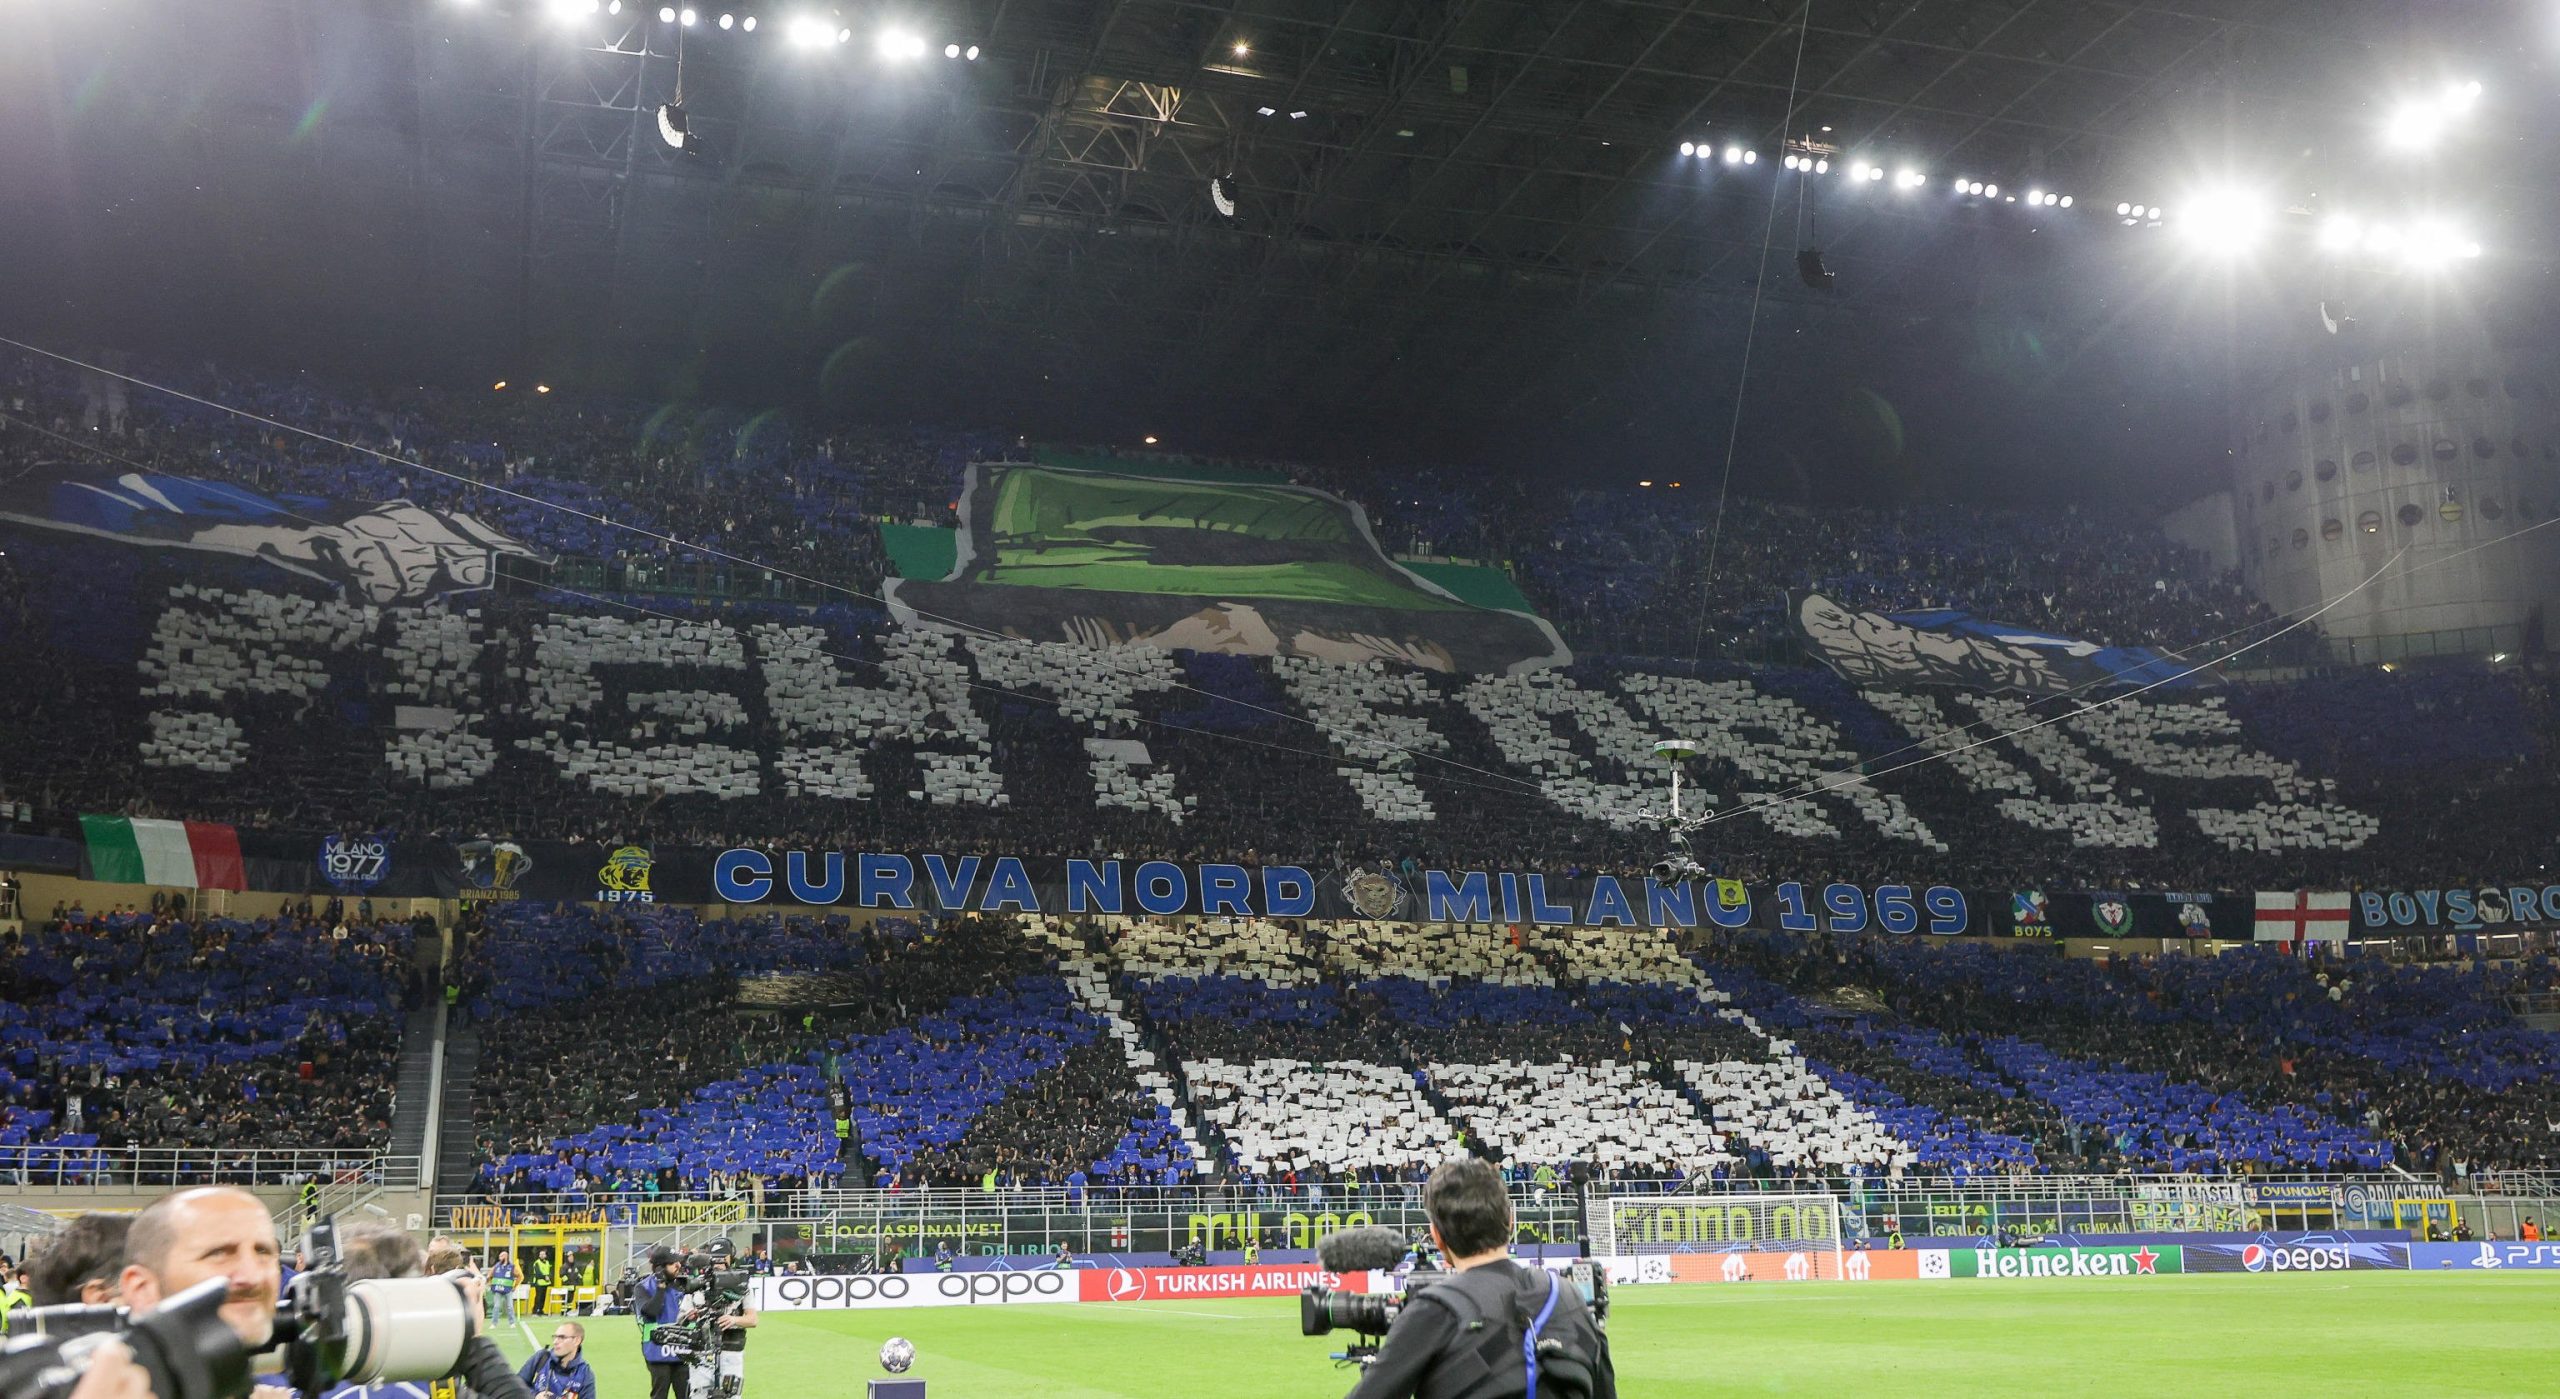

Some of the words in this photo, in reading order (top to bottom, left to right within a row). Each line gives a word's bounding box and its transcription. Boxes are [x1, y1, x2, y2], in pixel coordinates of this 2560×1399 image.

[325, 841, 385, 856] MILANO
[325, 854, 385, 875] 1977
[714, 848, 1041, 911] CURVA
[1066, 858, 1317, 917] NORD
[459, 888, 497, 900] BRIANZA
[598, 890, 653, 902] 1975
[1425, 869, 1752, 928] MILANO
[1779, 881, 1969, 935] 1969
[2359, 890, 2476, 928] BOYS
[2014, 925, 2052, 937] BOYS
[2261, 1186, 2331, 1197] OVUNQUE
[450, 1206, 511, 1233] RIVIERA
[641, 1205, 697, 1225] MONTALTO
[981, 1244, 1061, 1257] DELIRIO
[2272, 1242, 2350, 1272] pepsi
[1975, 1248, 2129, 1277] Heineken
[778, 1275, 909, 1307] oppo
[938, 1271, 1064, 1304] oppo
[1155, 1273, 1245, 1292] TURKISH
[1251, 1271, 1341, 1290] AIRLINES
